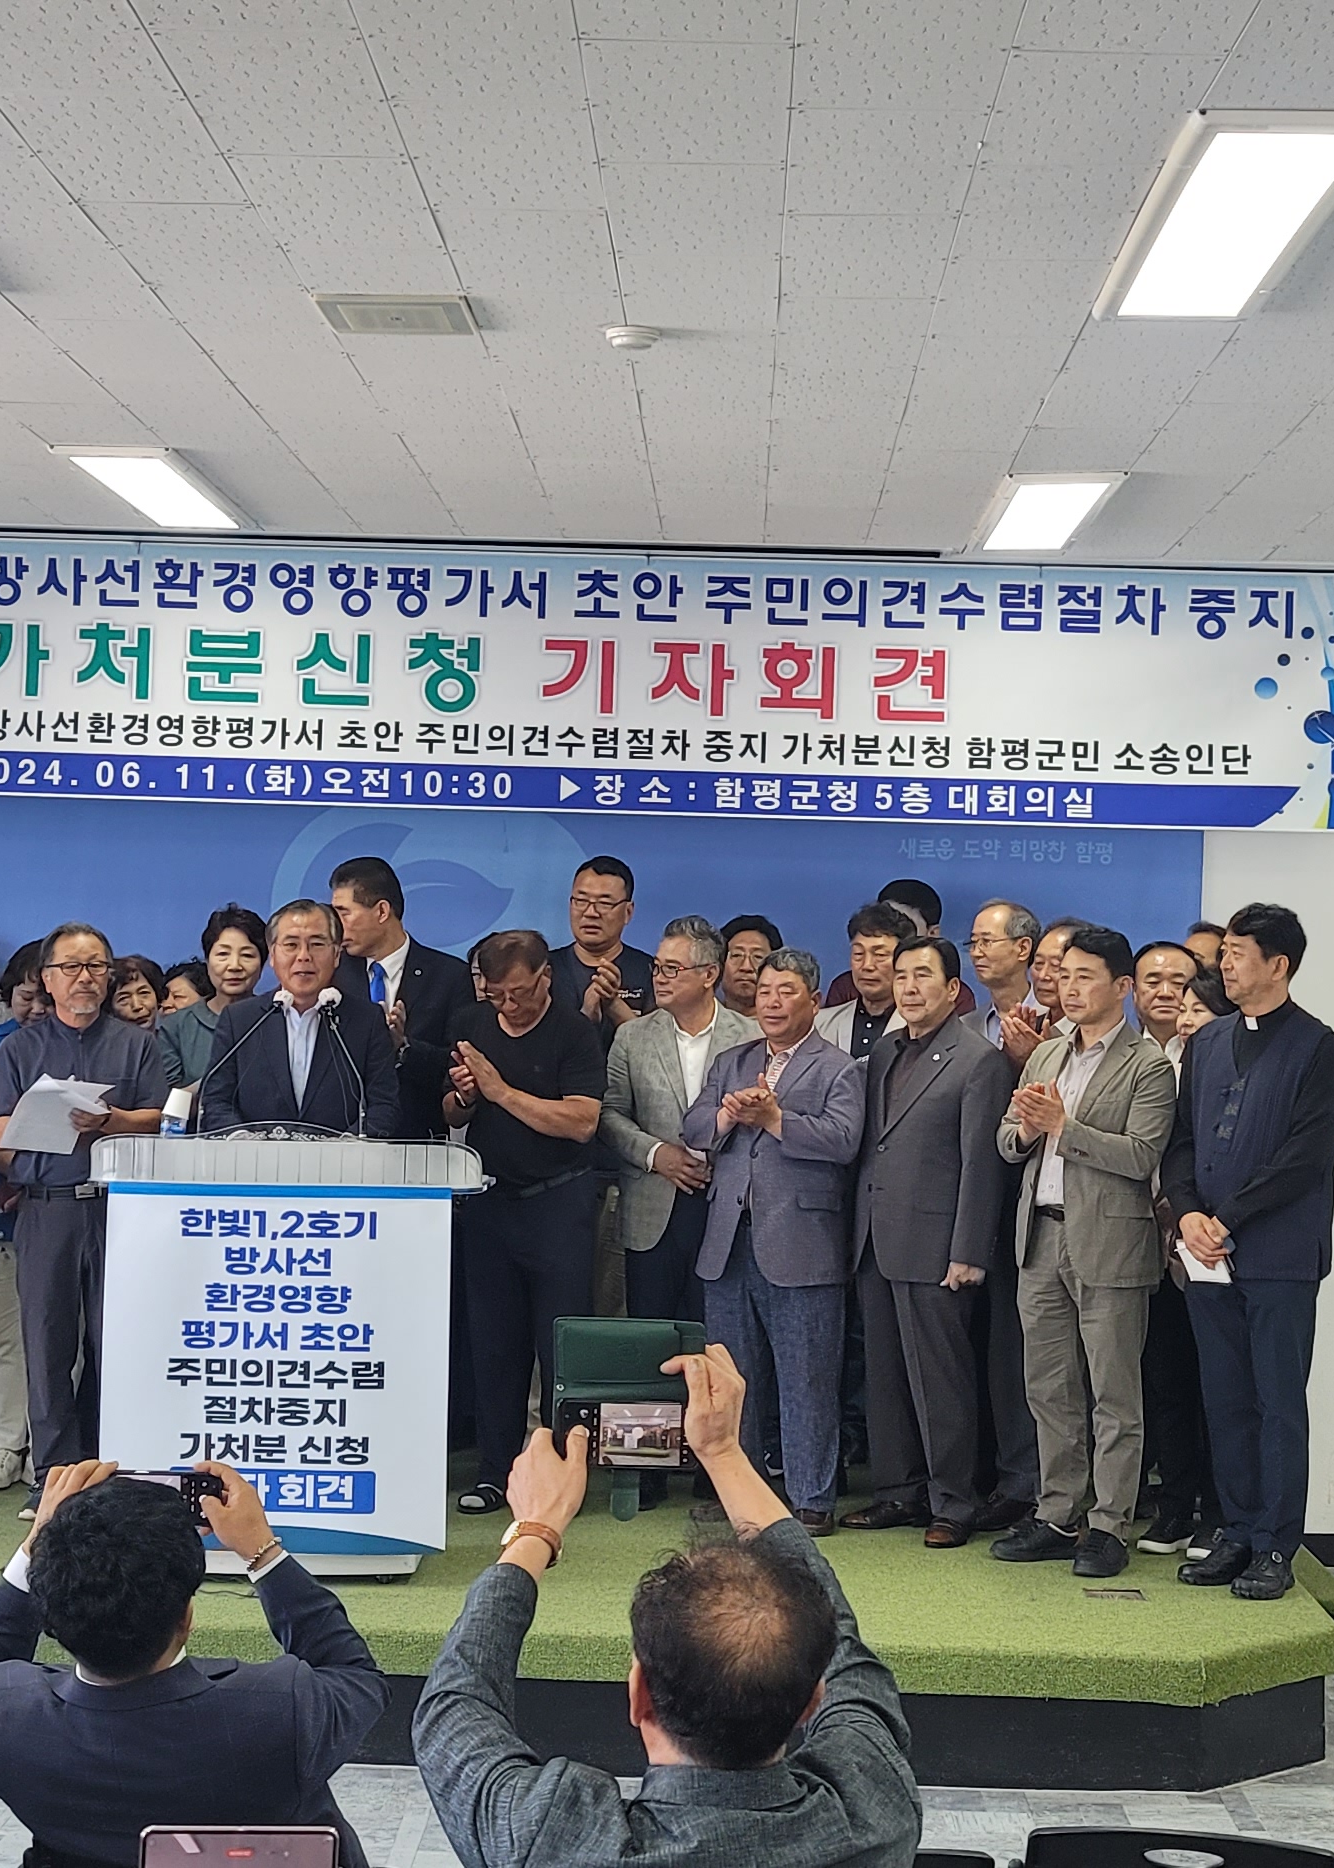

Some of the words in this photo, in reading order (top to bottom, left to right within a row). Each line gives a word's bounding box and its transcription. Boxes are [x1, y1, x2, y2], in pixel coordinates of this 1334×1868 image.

[574, 570, 684, 623] 초안
[705, 575, 1166, 636] 주민의견수렴절차
[1188, 588, 1295, 640] 중지
[541, 638, 947, 723] 기자회견
[336, 720, 404, 753] 초안
[415, 721, 691, 762] 주민의견수렴절차
[703, 729, 768, 764] 중지
[781, 732, 951, 768] 가처분신청
[965, 736, 1100, 772] 함평군민
[1113, 742, 1252, 776] 소송인단
[94, 761, 157, 788] 06.
[713, 777, 858, 813] 함평군청
[874, 783, 933, 814] 5층
[947, 785, 1094, 819] 대회의실
[898, 837, 955, 861] 새로운
[962, 838, 1001, 861] 도약
[1009, 839, 1067, 863] 희망찬
[1076, 841, 1113, 865] 함평
[179, 1208, 378, 1241] 한빛1,2호기
[223, 1247, 333, 1277] 방사선
[204, 1282, 352, 1314] 환경영향
[181, 1320, 290, 1351] 평가서
[300, 1323, 374, 1353] 초안
[166, 1358, 385, 1390] 주민의견수렴
[203, 1395, 347, 1427] 절차중지
[179, 1433, 287, 1463] 가처분
[298, 1436, 370, 1466] 신청
[277, 1474, 354, 1509] 회견
